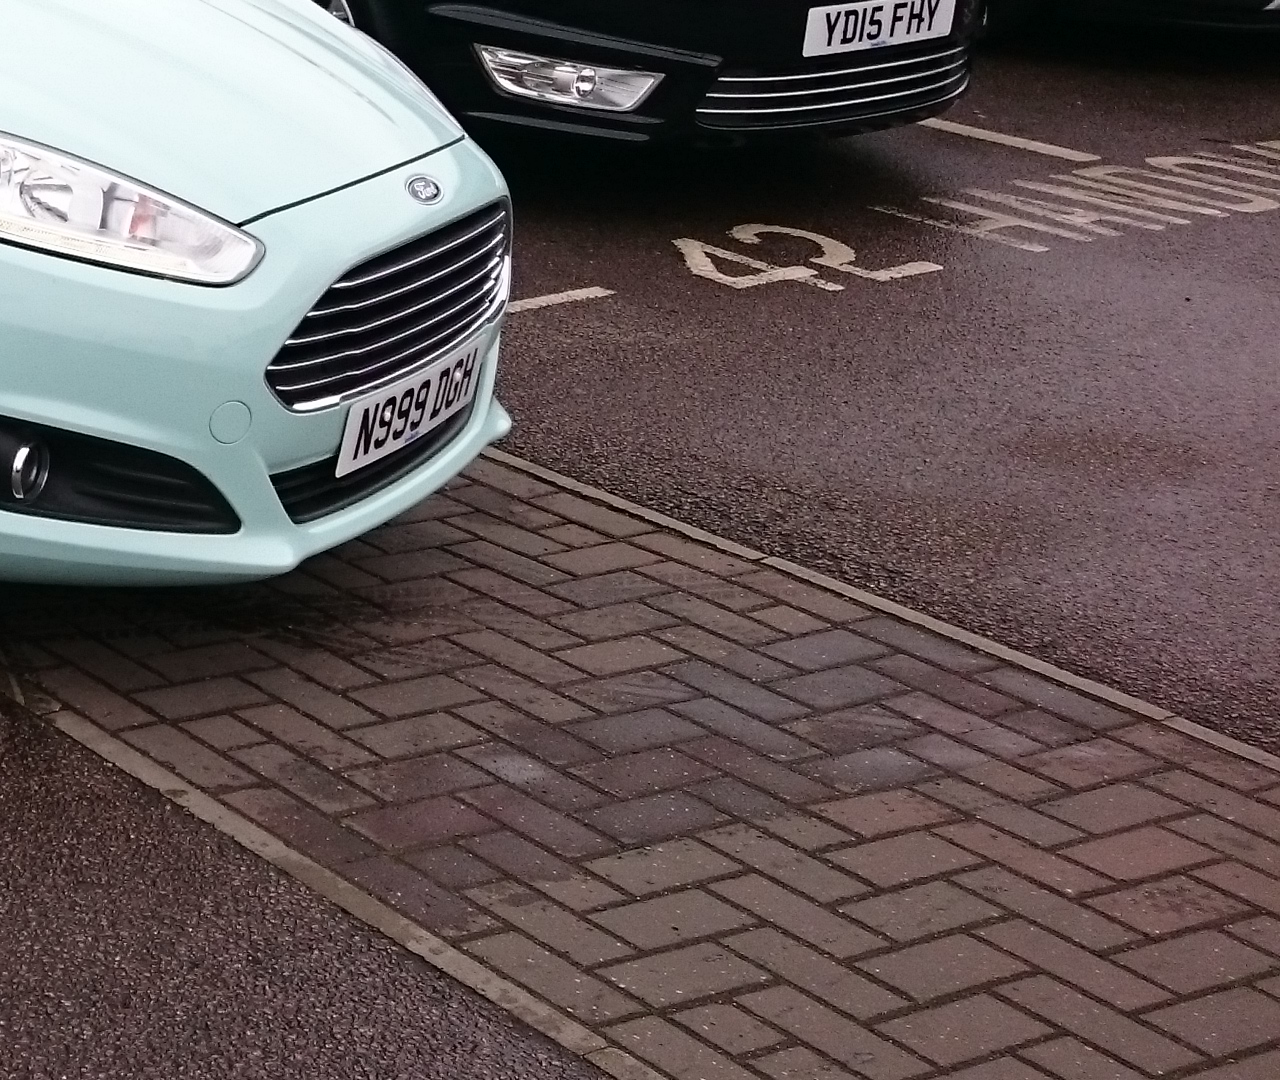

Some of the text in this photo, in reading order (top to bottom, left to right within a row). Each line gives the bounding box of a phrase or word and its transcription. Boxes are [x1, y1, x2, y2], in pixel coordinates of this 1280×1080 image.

[825, 5, 884, 48] YD15
[669, 222, 945, 292] 42
[351, 378, 431, 462] N999
